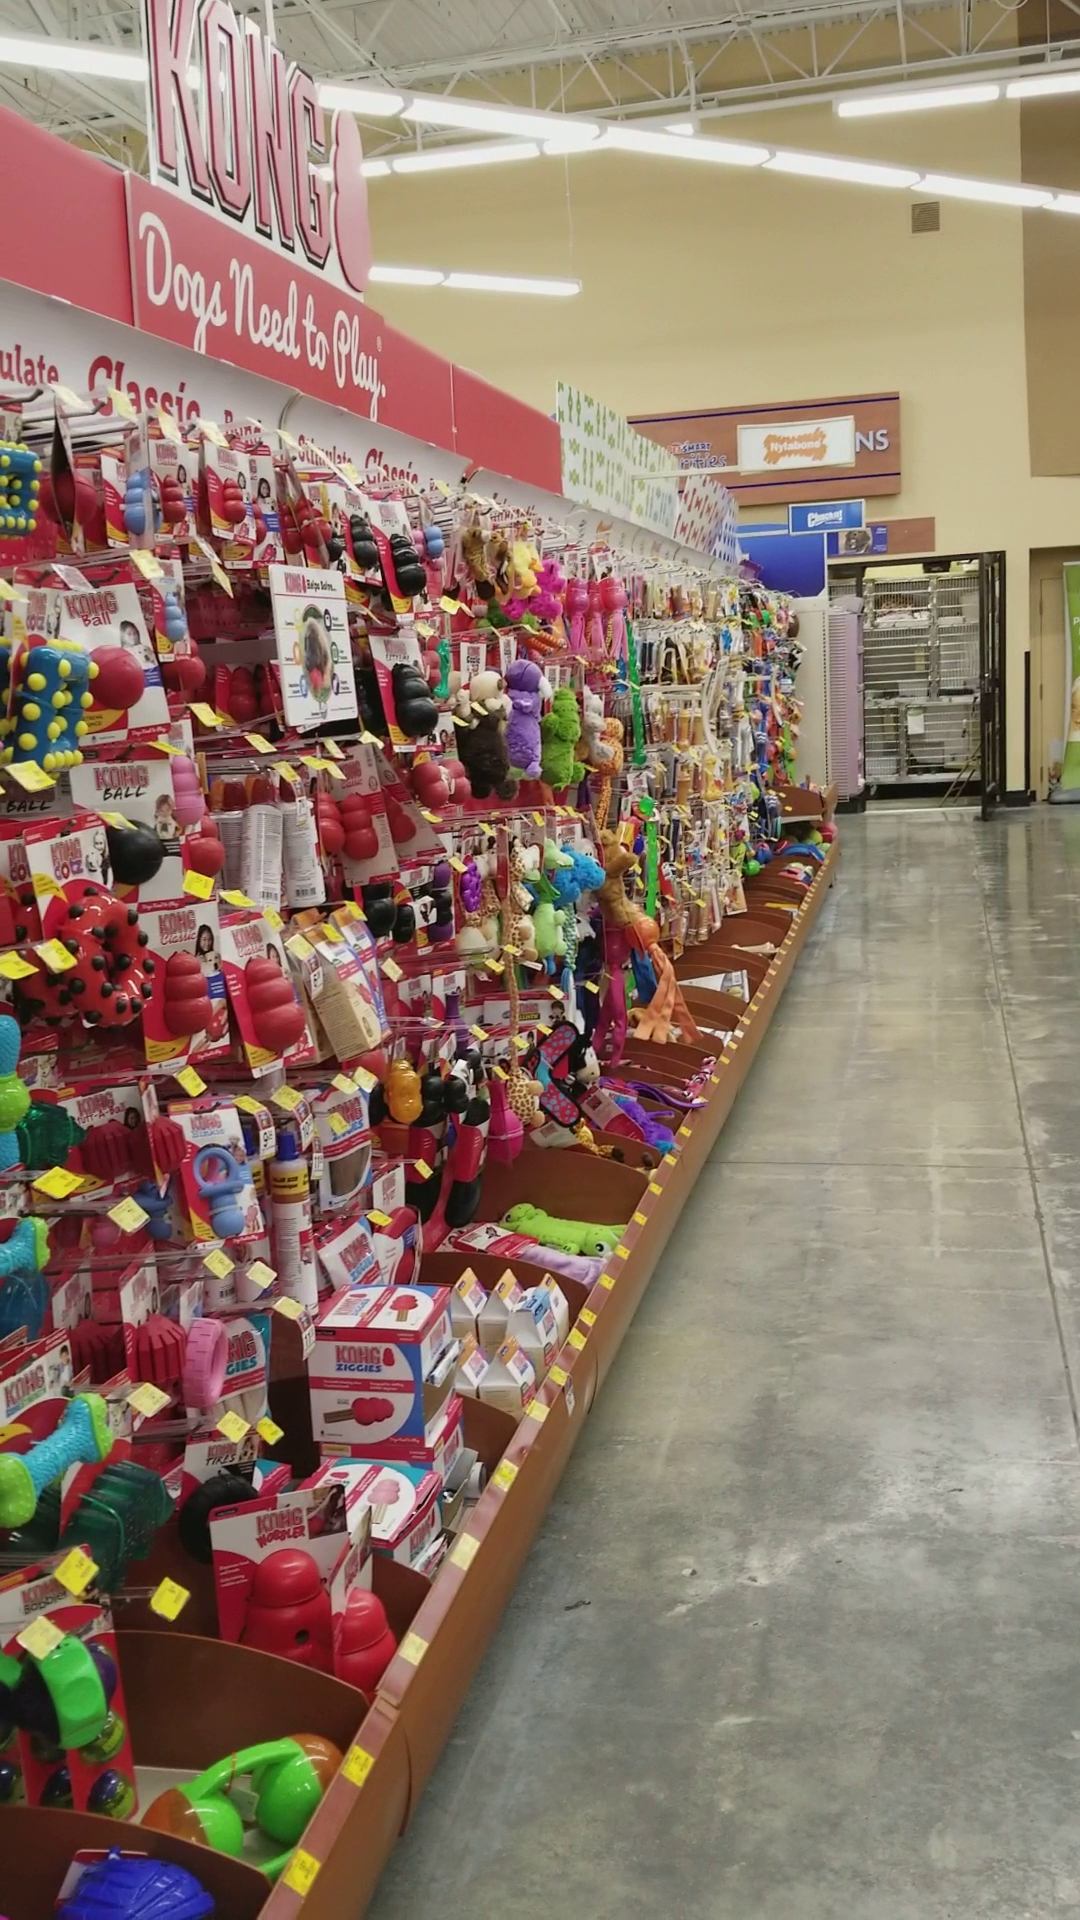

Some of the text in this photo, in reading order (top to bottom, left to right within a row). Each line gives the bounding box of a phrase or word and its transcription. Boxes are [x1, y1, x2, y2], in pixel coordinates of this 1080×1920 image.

[146, 0, 332, 270] KONG
[138, 211, 228, 354] Dogs
[229, 258, 301, 360] Need
[302, 293, 330, 371] to
[770, 439, 821, 453] Nylabone
[63, 590, 119, 619] KONG
[82, 612, 112, 627] Ball
[94, 765, 149, 791] KONG
[103, 785, 147, 801] BALL
[7, 800, 52, 813] BALL
[50, 837, 83, 866] KONG
[158, 909, 197, 934] KONG
[161, 929, 197, 946] Classic
[231, 924, 263, 948] KONG
[76, 1092, 115, 1117] KONG
[335, 1344, 382, 1365] KONG
[335, 1363, 382, 1373] ZIGGIES
[4, 1364, 45, 1409] KONG
[205, 1453, 237, 1467] TIRES
[207, 1443, 238, 1459] KONG
[256, 1506, 304, 1535] KONG
[256, 1525, 306, 1548] WOBBLER
